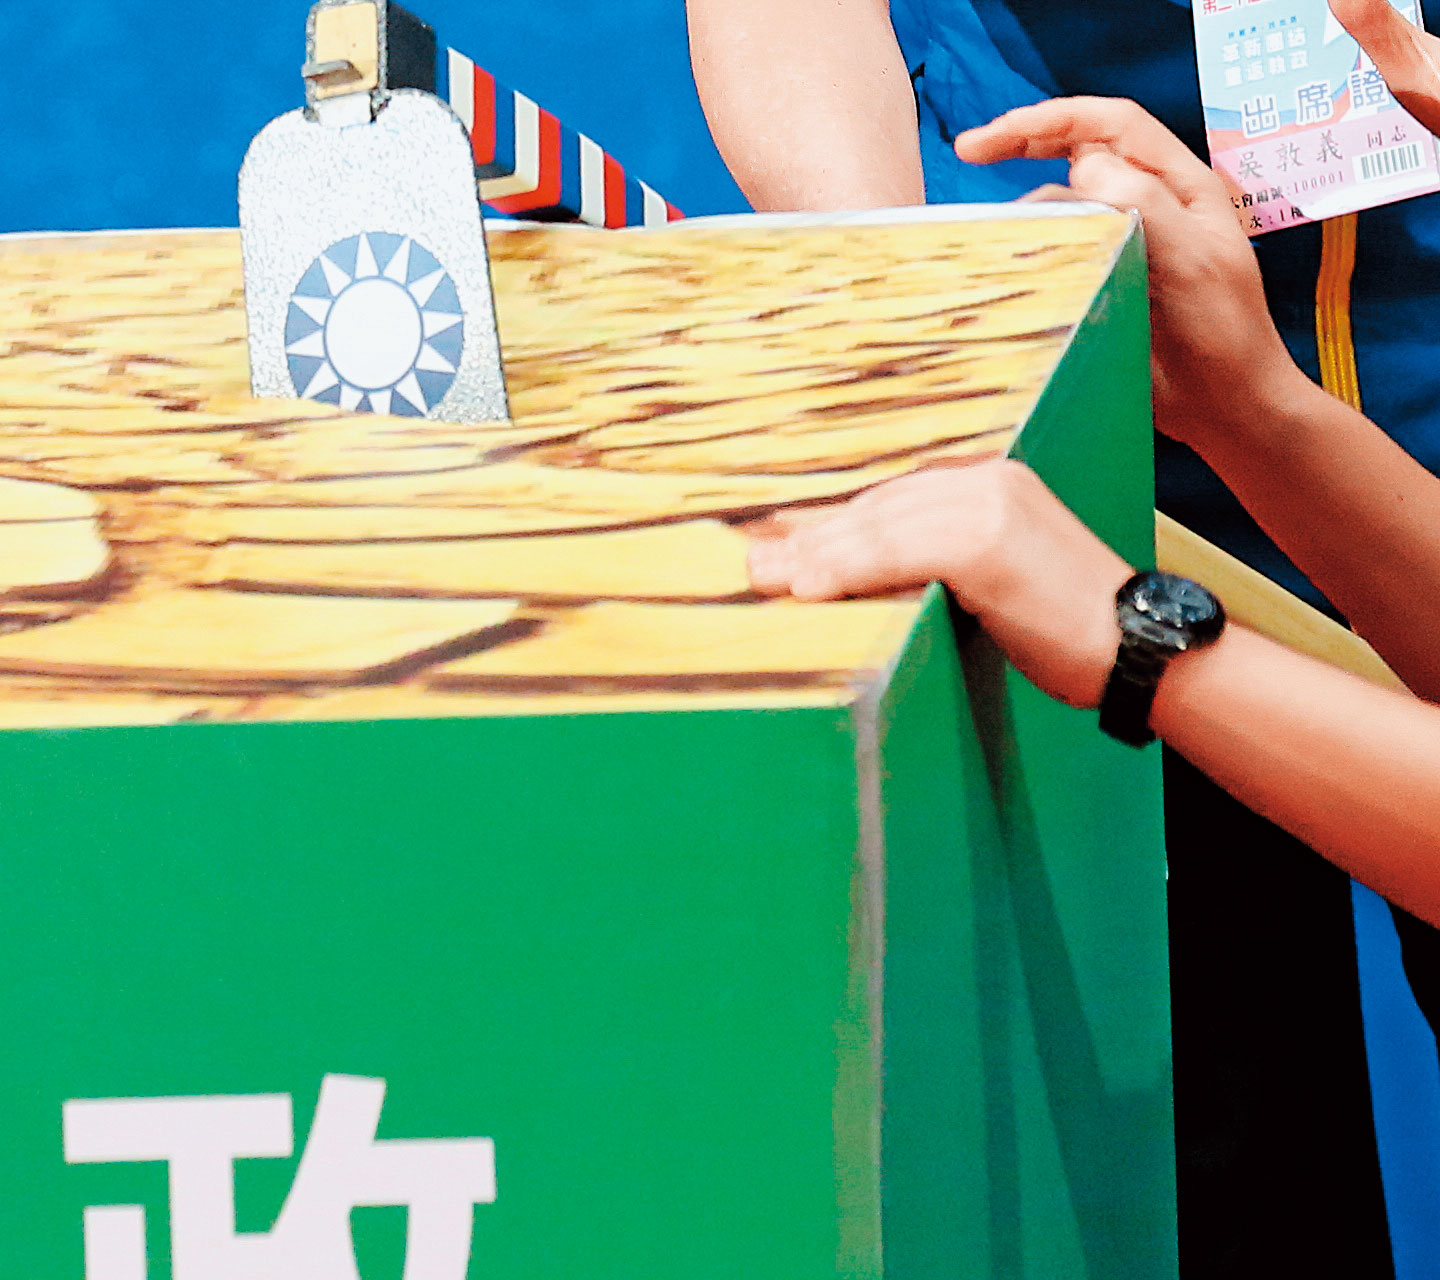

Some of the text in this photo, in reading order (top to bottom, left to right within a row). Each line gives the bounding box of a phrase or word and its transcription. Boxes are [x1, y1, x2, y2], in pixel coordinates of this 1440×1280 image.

[1243, 69, 1387, 135] 出席證
[1238, 129, 1343, 179] 吳敦義
[1367, 125, 1406, 148] 同志
